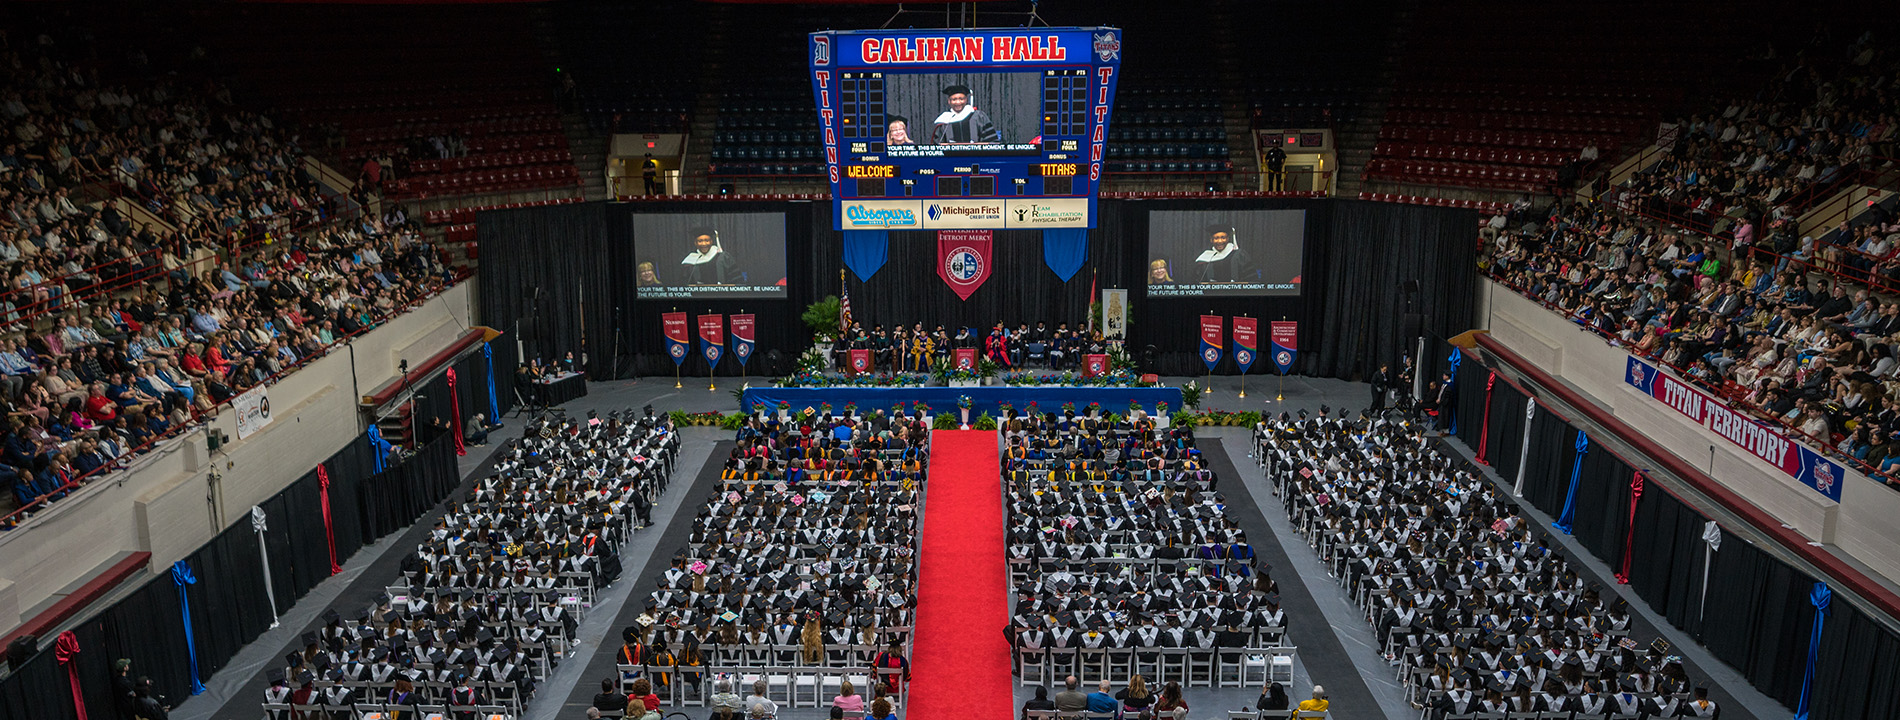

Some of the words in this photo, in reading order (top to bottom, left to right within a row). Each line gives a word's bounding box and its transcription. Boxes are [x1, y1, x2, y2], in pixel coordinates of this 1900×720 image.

[862, 36, 984, 63] CALIHAN
[992, 36, 1066, 62] HALL
[816, 70, 838, 183] TITANS
[1091, 66, 1113, 181] TITANS
[848, 166, 894, 177] WELCOME
[1040, 164, 1076, 175] TITANS
[846, 204, 914, 227] Absopure
[943, 206, 980, 216] Michigan
[981, 206, 1000, 214] First
[1664, 378, 1702, 421] TITAN
[1705, 400, 1789, 468] TERRITORY
